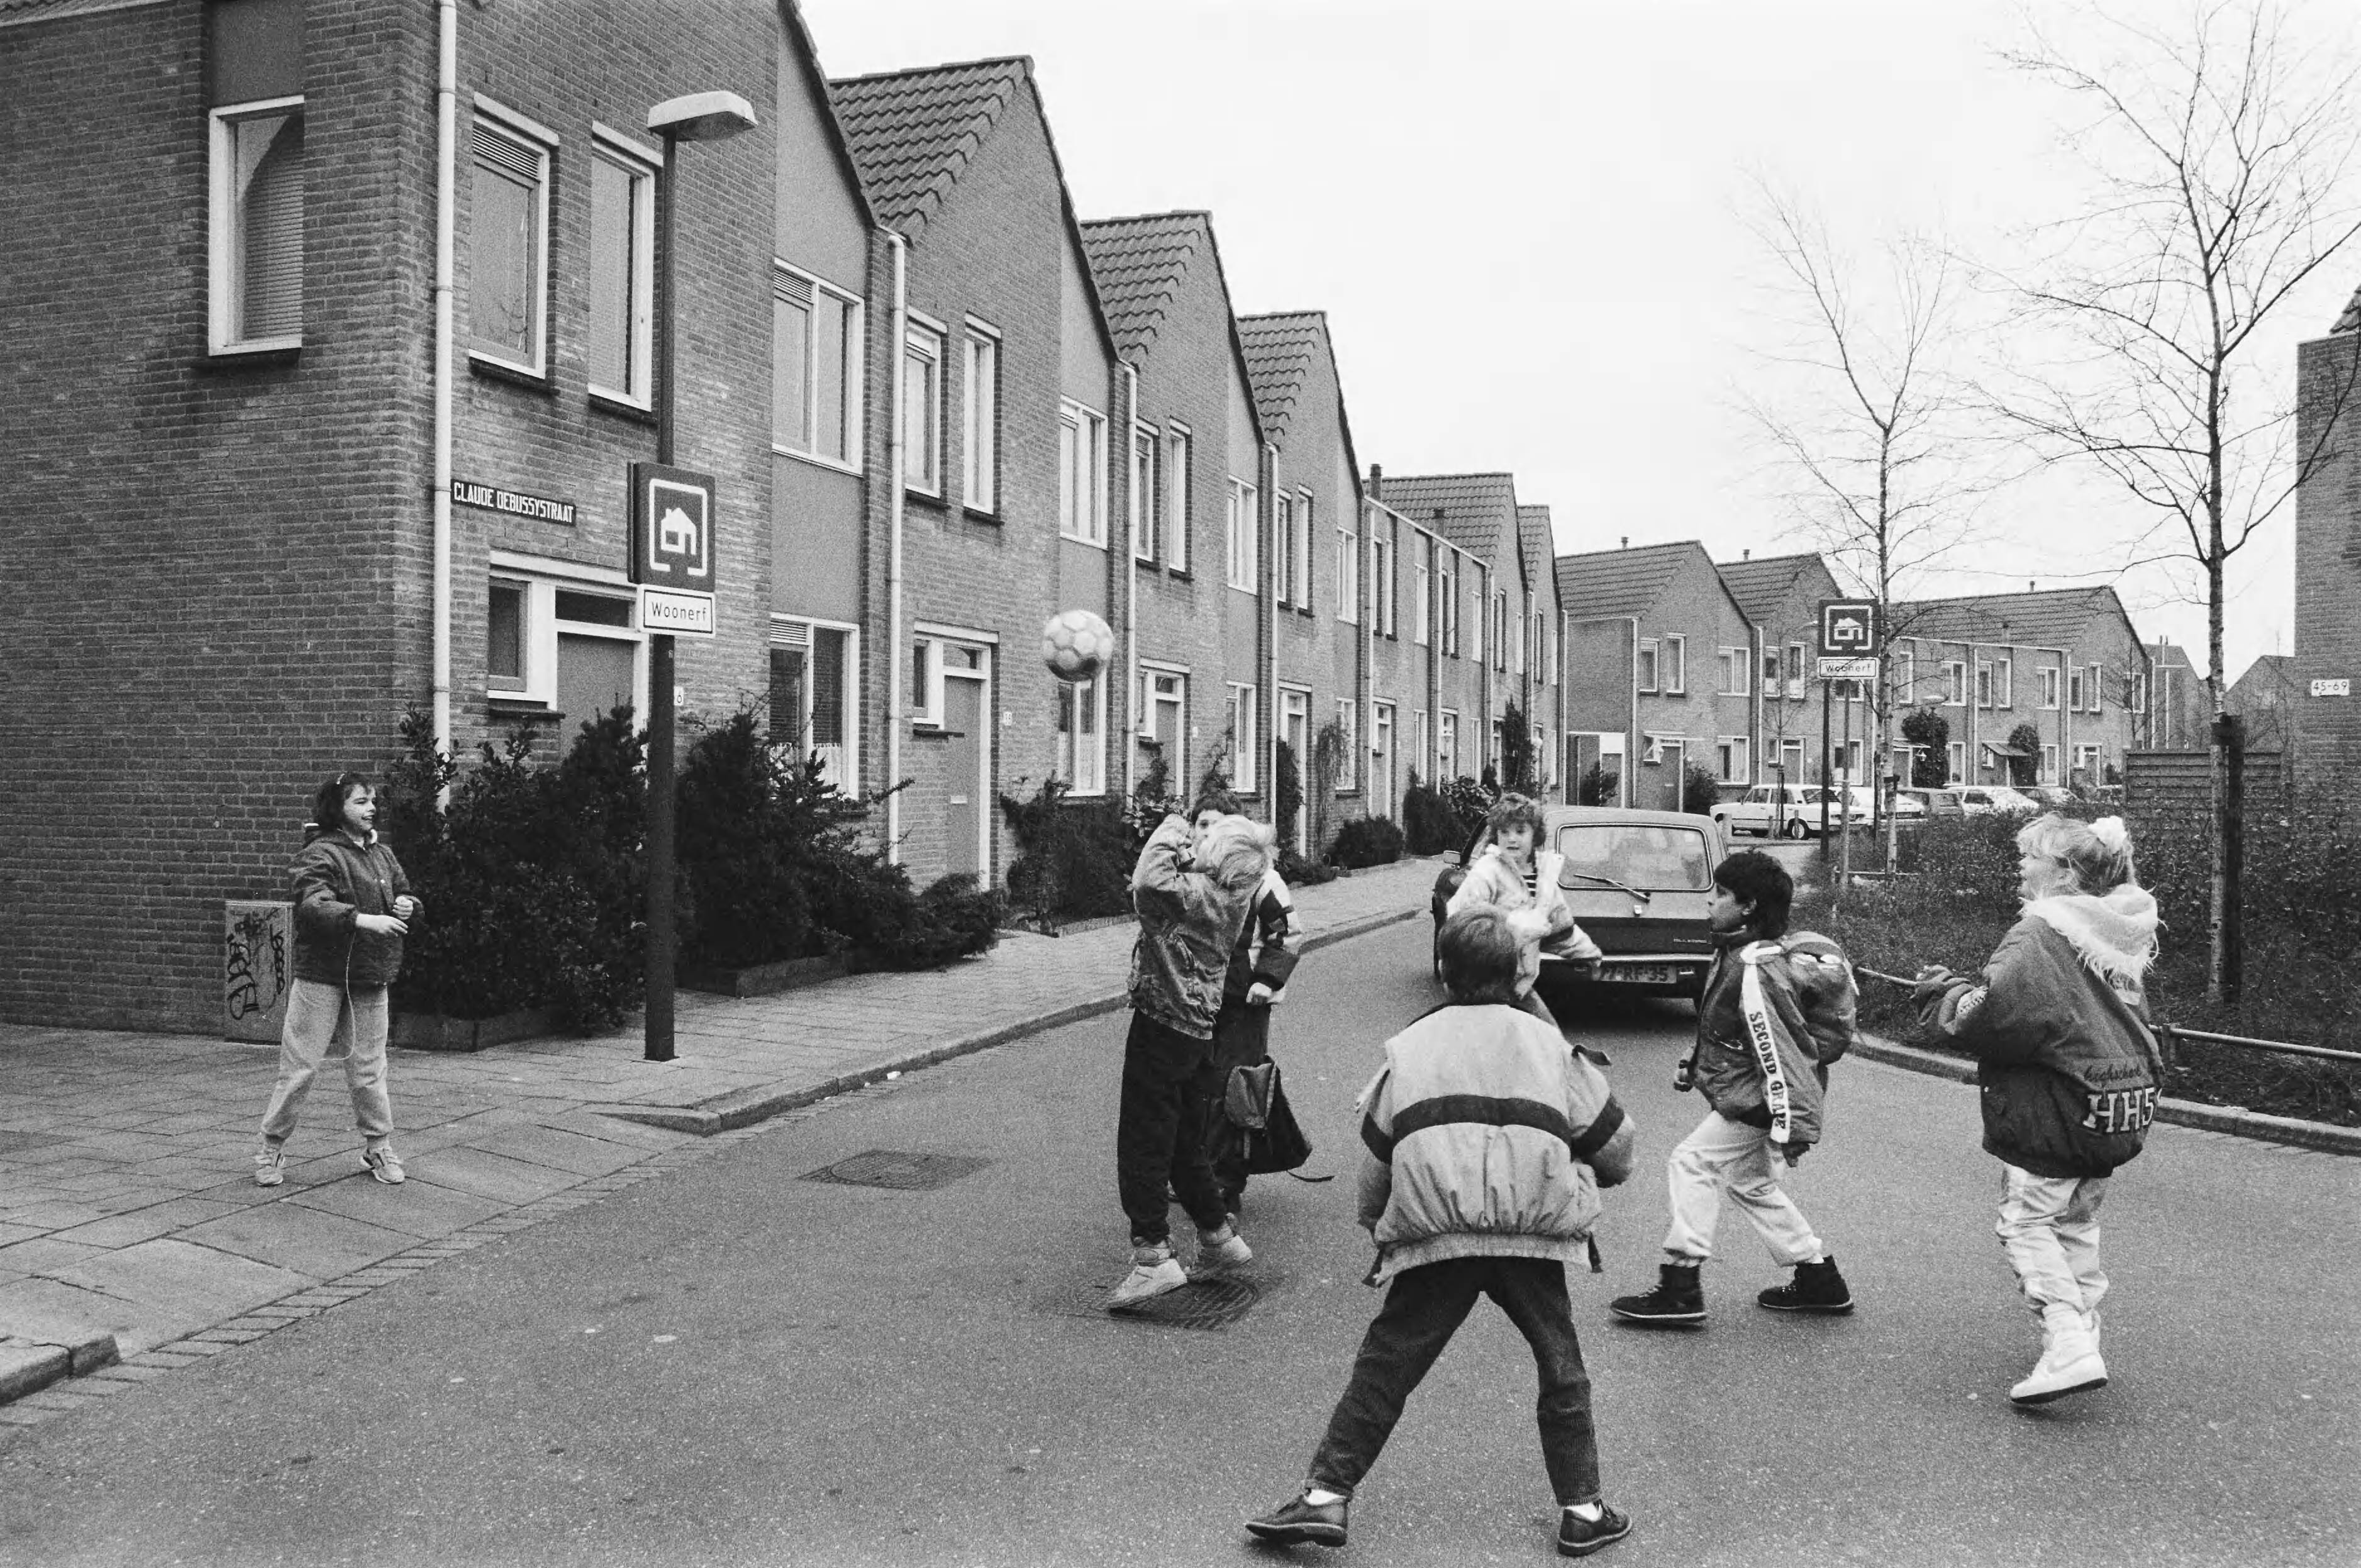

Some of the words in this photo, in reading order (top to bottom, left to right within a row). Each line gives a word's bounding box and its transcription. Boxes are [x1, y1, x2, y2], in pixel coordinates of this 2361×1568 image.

[453, 482, 494, 508] CLAUDE
[496, 490, 574, 523] DEBUSSYSTRAAT
[652, 601, 707, 621] Woonerf
[1826, 663, 1871, 672] Woonerf
[2314, 681, 2348, 691] 45-69
[1749, 1011, 1777, 1075] SECOND
